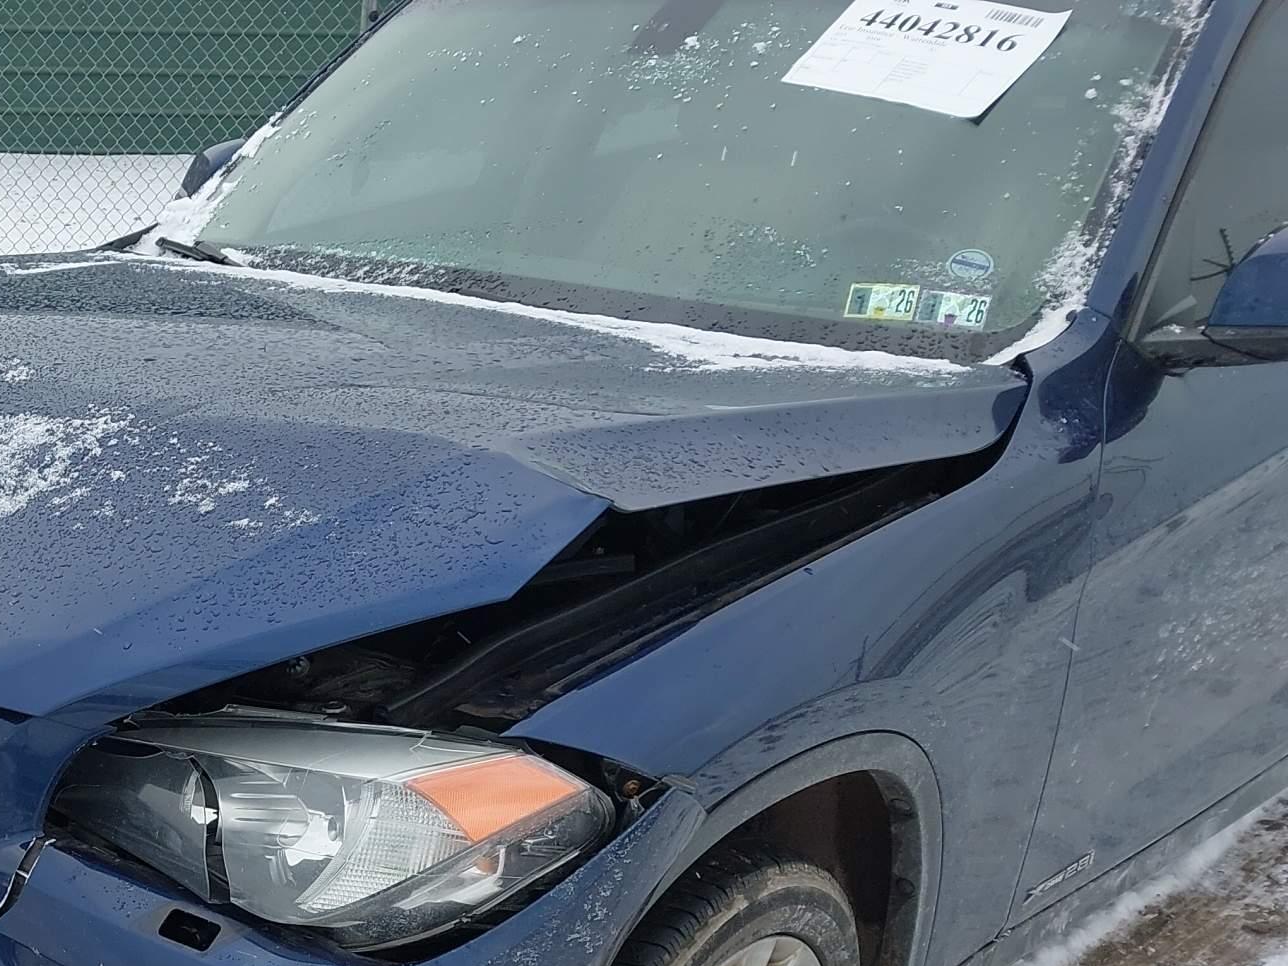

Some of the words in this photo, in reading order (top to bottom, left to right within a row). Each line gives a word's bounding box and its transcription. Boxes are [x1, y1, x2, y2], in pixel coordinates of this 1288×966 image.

[859, 8, 1026, 53] 44042816
[895, 289, 916, 314] 26
[966, 298, 988, 324] 26
